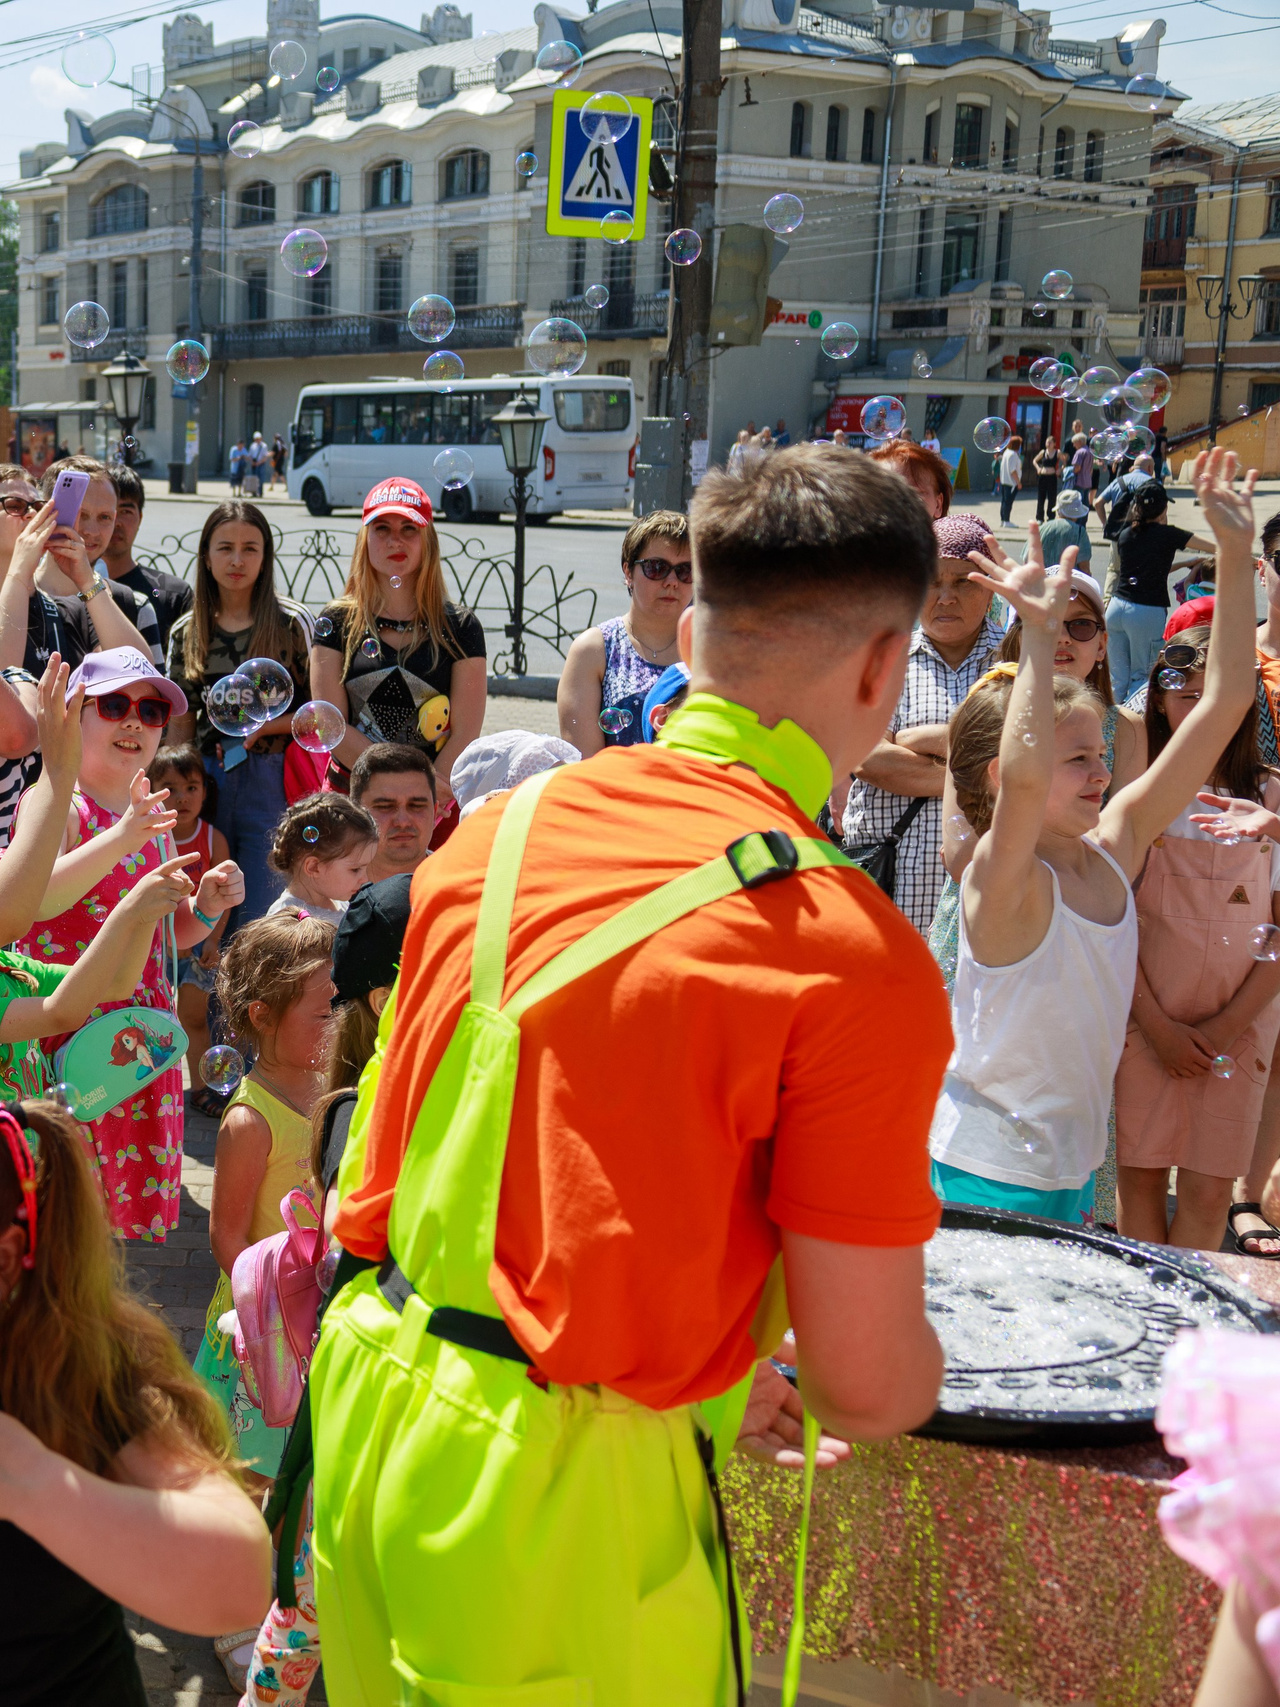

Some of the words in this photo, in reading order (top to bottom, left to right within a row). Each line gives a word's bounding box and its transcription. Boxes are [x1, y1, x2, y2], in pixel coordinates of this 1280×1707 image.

[771, 312, 807, 324] PAR
[372, 486, 400, 499] TEAM
[369, 494, 388, 508] CZECH
[389, 494, 422, 507] REPUBLIC
[201, 684, 254, 706] didas
